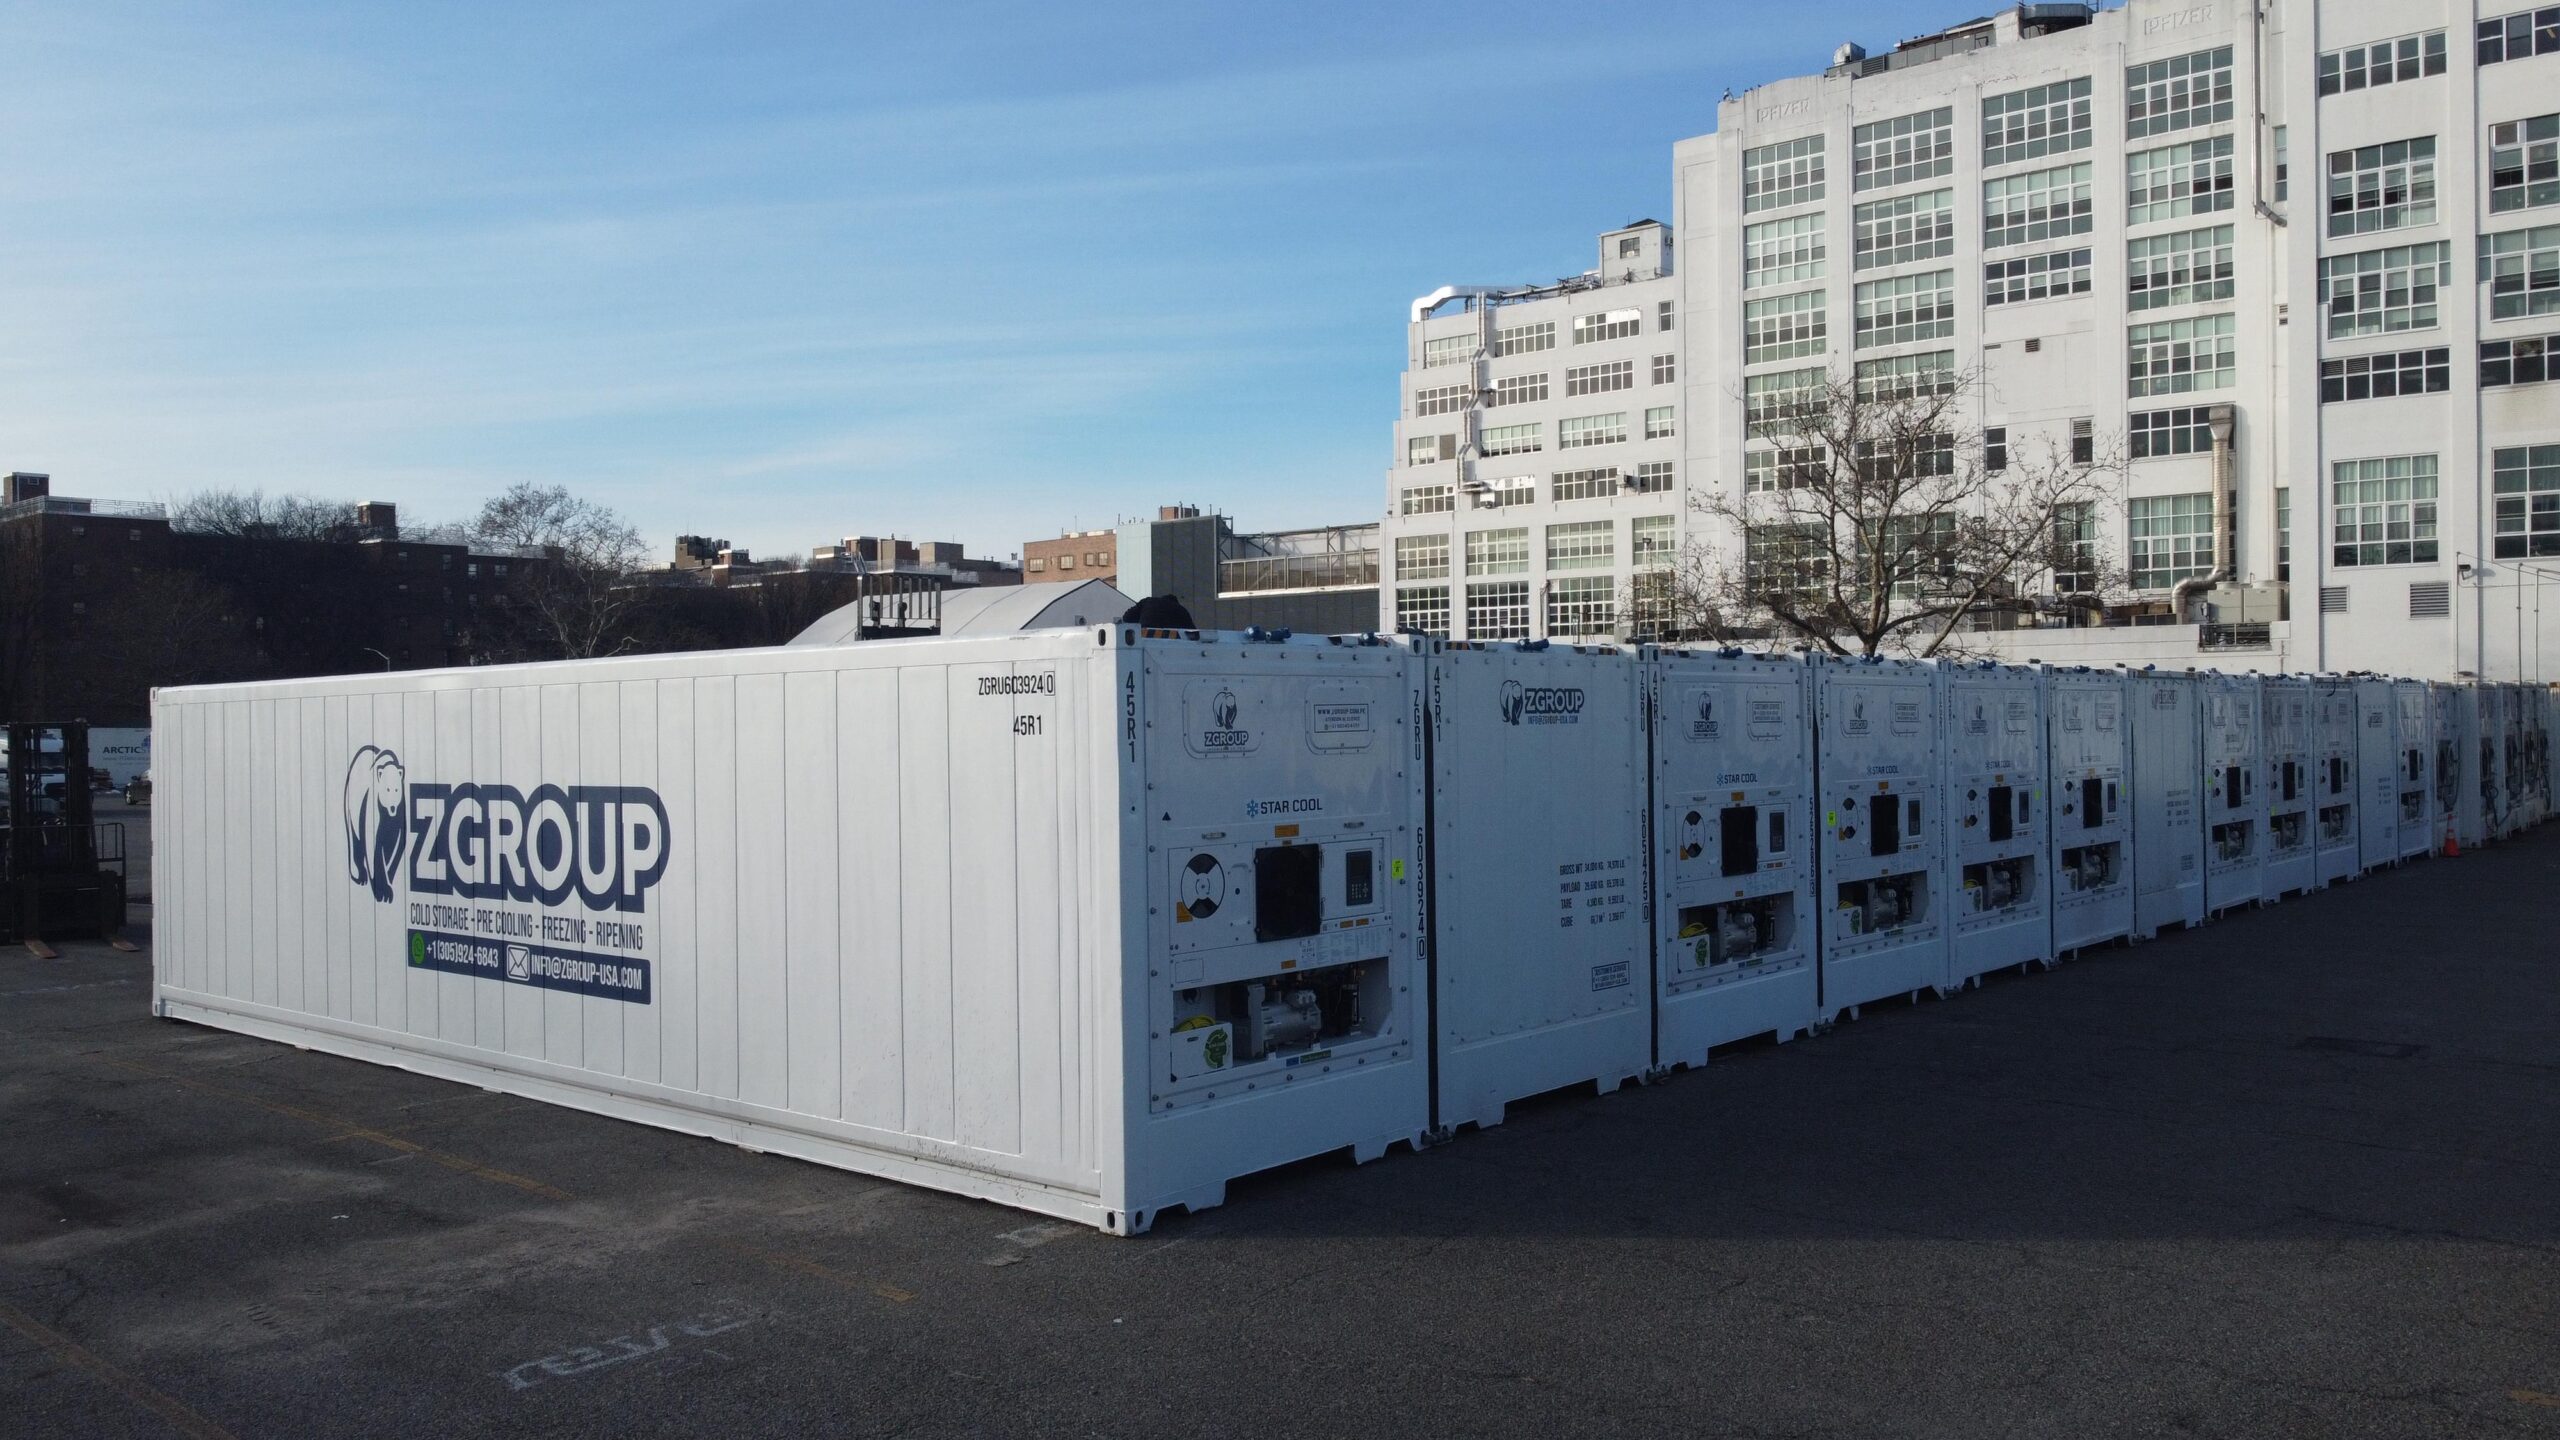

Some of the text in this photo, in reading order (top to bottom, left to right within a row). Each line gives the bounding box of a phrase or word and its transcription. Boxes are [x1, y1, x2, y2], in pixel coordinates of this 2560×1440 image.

[2144, 4, 2212, 36] PFIZER
[1756, 100, 1809, 124] PFIZER
[978, 671, 1055, 696] ZGRU6039240
[1433, 666, 1442, 743] 45R1
[1524, 688, 1584, 714] ZGROUP
[1639, 671, 1647, 732] ZGRU
[1013, 715, 1042, 736] 45R1
[1125, 671, 1137, 763] 45R1
[1204, 731, 1248, 747] ZGROUP
[1724, 773, 1757, 784] STAR COOL
[1260, 798, 1322, 815] STAR COOL
[1413, 690, 1426, 960] ZGRU 6039240
[410, 785, 670, 912] ZGROUP
[1561, 881, 1580, 894] PAYLOAD
[1561, 898, 1572, 909] TARE
[410, 903, 430, 927] COLD
[432, 905, 469, 932] STORAGE
[476, 908, 494, 933] PRE
[495, 910, 533, 939] COOLING
[542, 914, 586, 944] FREEZING
[595, 921, 643, 951] RIPENING
[426, 940, 643, 990] +1(305)924-6843 INFO@ZGROUP-USA.COM
